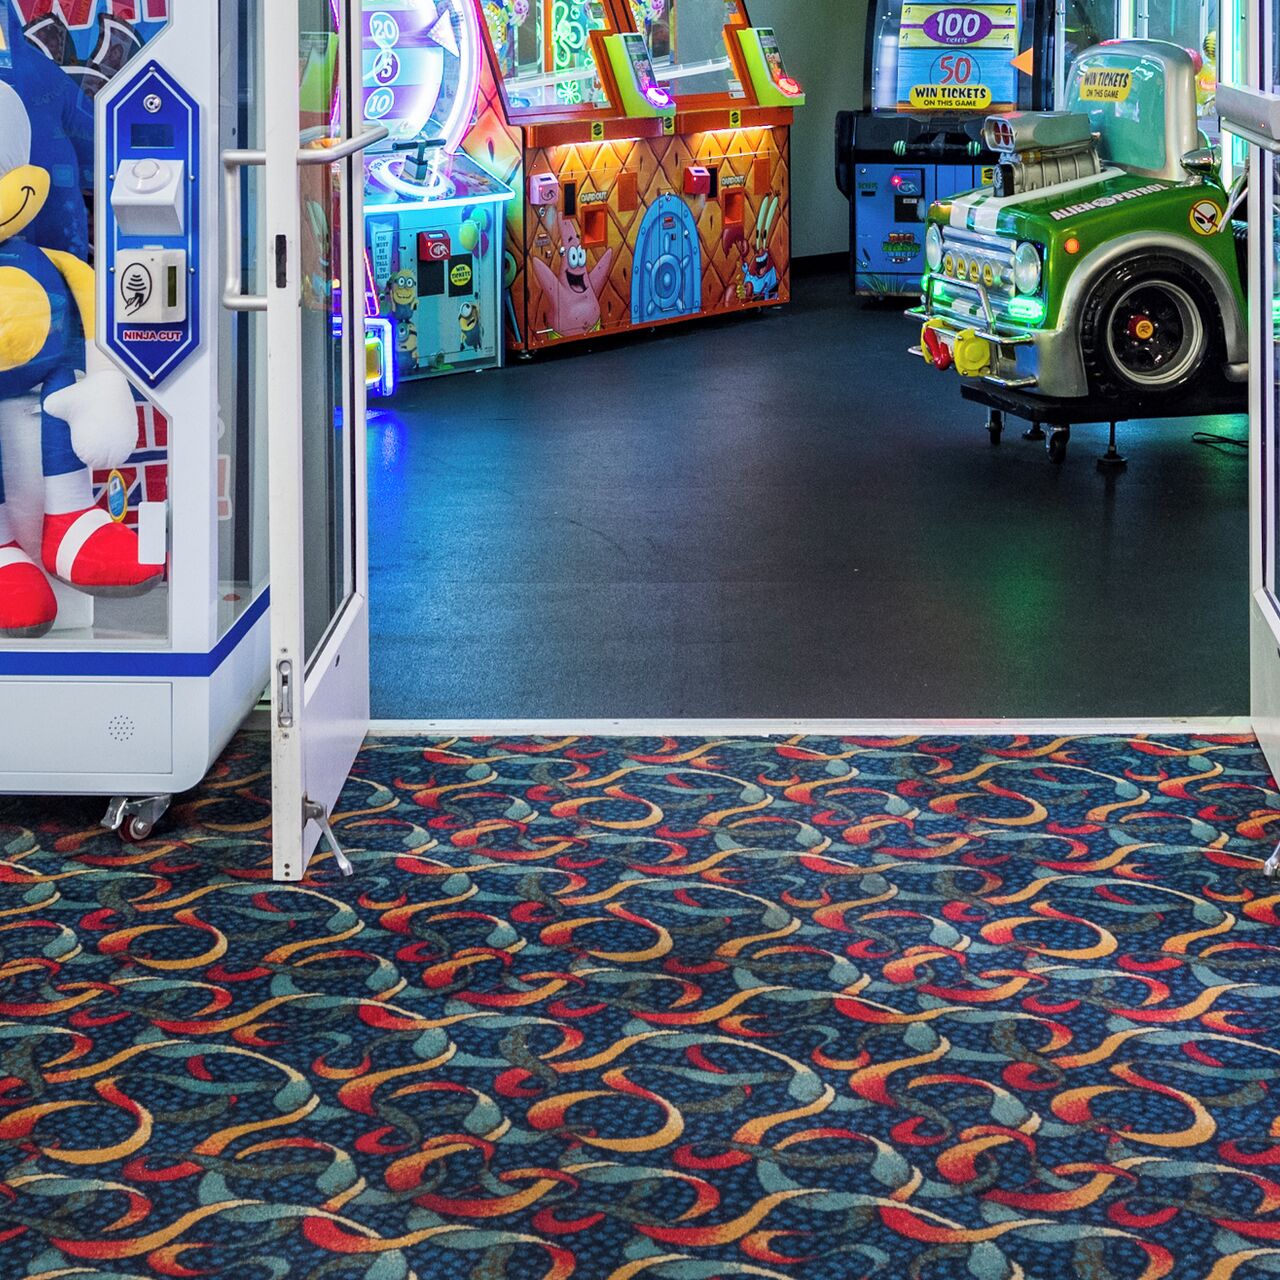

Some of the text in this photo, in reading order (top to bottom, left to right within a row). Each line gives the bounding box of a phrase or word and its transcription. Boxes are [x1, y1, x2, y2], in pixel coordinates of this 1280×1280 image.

[372, 20, 396, 37] 20
[936, 12, 980, 37] 100
[940, 55, 971, 84] 50
[1084, 72, 1129, 88] WIN TICKETS
[915, 88, 986, 99] WIN TICKETS
[1104, 90, 1119, 98] GAME
[366, 95, 390, 112] 10
[1049, 183, 1170, 221] ALIEN PATROL
[123, 330, 183, 342] NINJA CUT
